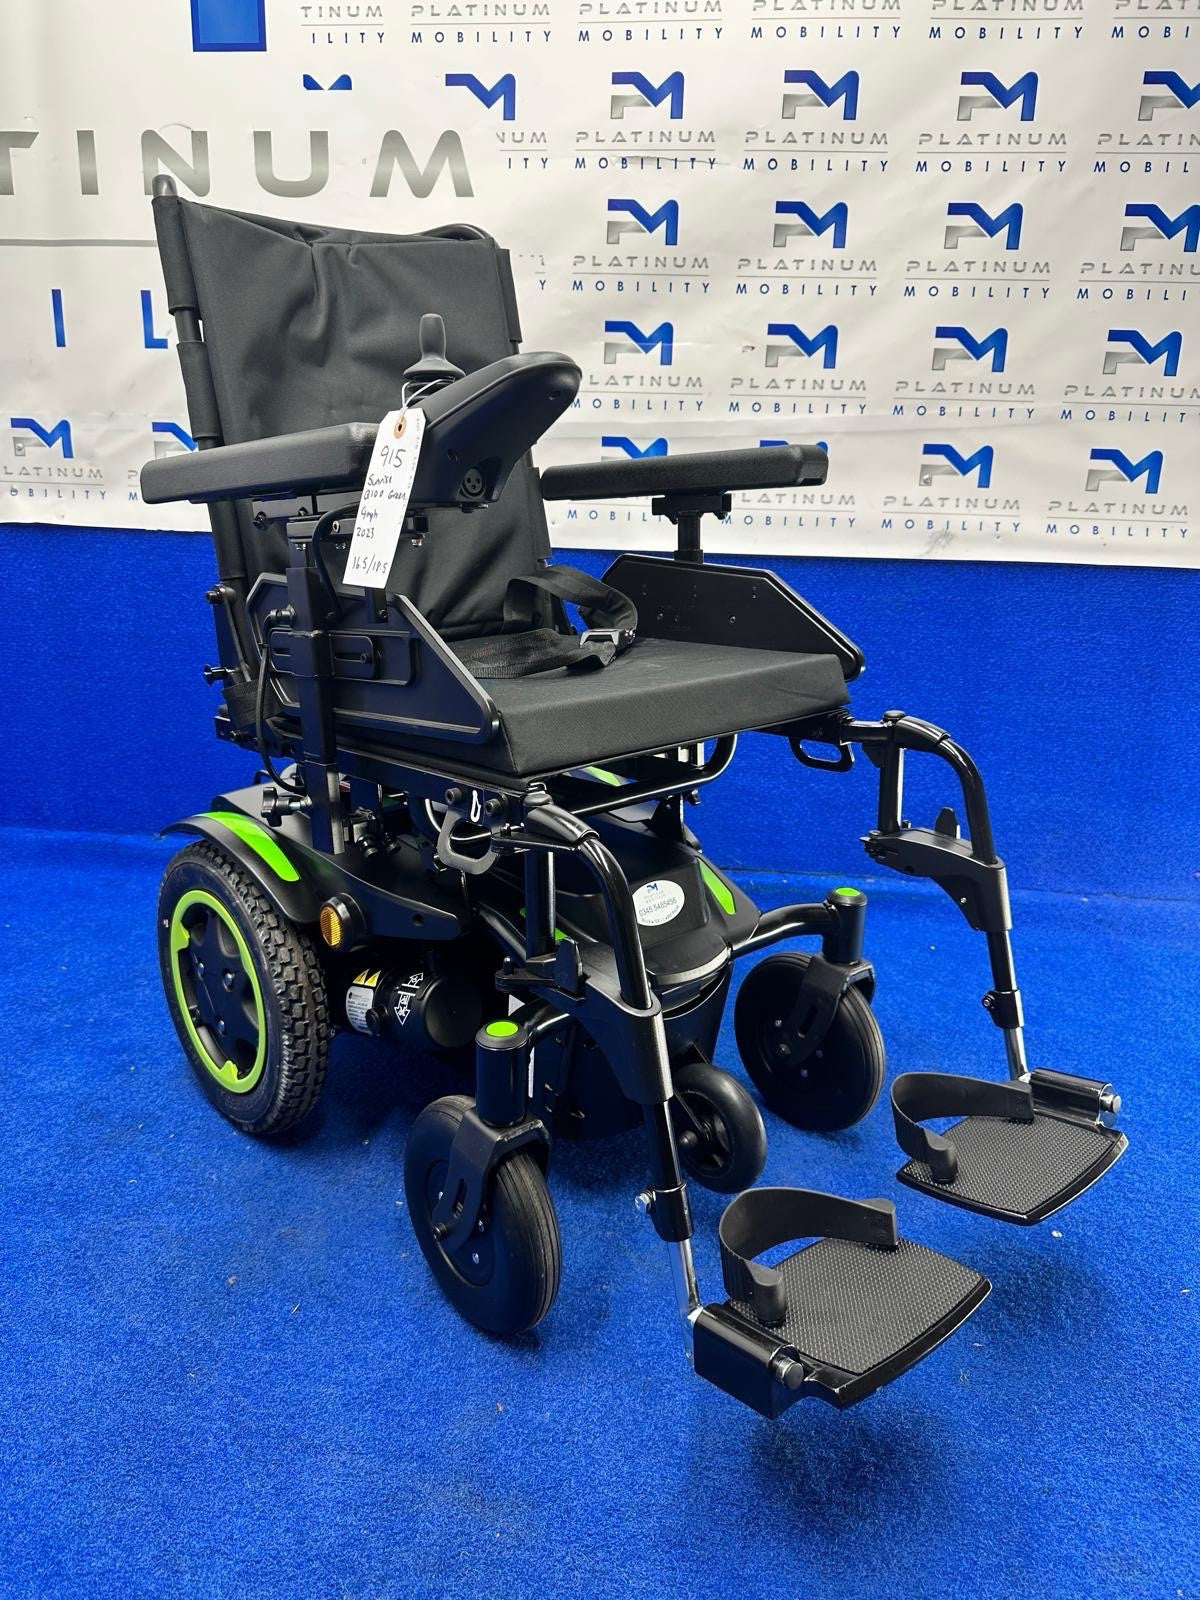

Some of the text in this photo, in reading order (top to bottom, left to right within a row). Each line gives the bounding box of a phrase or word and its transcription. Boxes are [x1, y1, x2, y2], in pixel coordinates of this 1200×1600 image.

[300, 6, 383, 18] TINUM
[410, 4, 550, 17] PLATINUM
[578, 0, 722, 15] PLATINUM
[752, 0, 901, 11] PLATINUM
[932, 0, 1083, 11] PLATINUM
[1115, 0, 1200, 10] PLATI
[411, 31, 551, 43] MOBILITY
[578, 28, 723, 42] MOBILITY
[750, 26, 901, 39] MOBILITY
[928, 26, 1083, 39] MOBILITY
[575, 131, 716, 143] PLATINUM
[745, 131, 889, 146] PLATINUM
[919, 133, 1068, 147] PLATINUM
[574, 157, 716, 169] MOBILITY
[743, 158, 889, 172] MOBILITY
[916, 160, 1066, 173] MOBILITY
[572, 255, 709, 269] PLATINUM
[738, 257, 877, 272] PLATINUM
[906, 260, 1051, 274] PLATINUM
[572, 279, 709, 293] MOBILITY
[736, 283, 877, 296] MOBILITY
[904, 285, 1050, 300] MOBILITY
[1077, 288, 1200, 301] MOBILI
[589, 374, 703, 388] LATINUM
[730, 376, 866, 391] PLATINUM
[895, 380, 1035, 396] PLATINUM
[571, 398, 703, 411] MOBILITY
[729, 401, 866, 415] MOBILITY
[892, 404, 1034, 419] MOBILITY
[1060, 409, 1200, 424] MOBILIT
[380, 445, 407, 468] 915
[732, 492, 856, 506] LATINUM
[884, 495, 1019, 511] PLATINUM
[1048, 501, 1188, 516] PLATINUM
[721, 513, 856, 528] MOBILITY
[882, 517, 1020, 533] MOBILITY
[356, 526, 375, 539] 2023
[1046, 523, 1188, 539] MOBILITY
